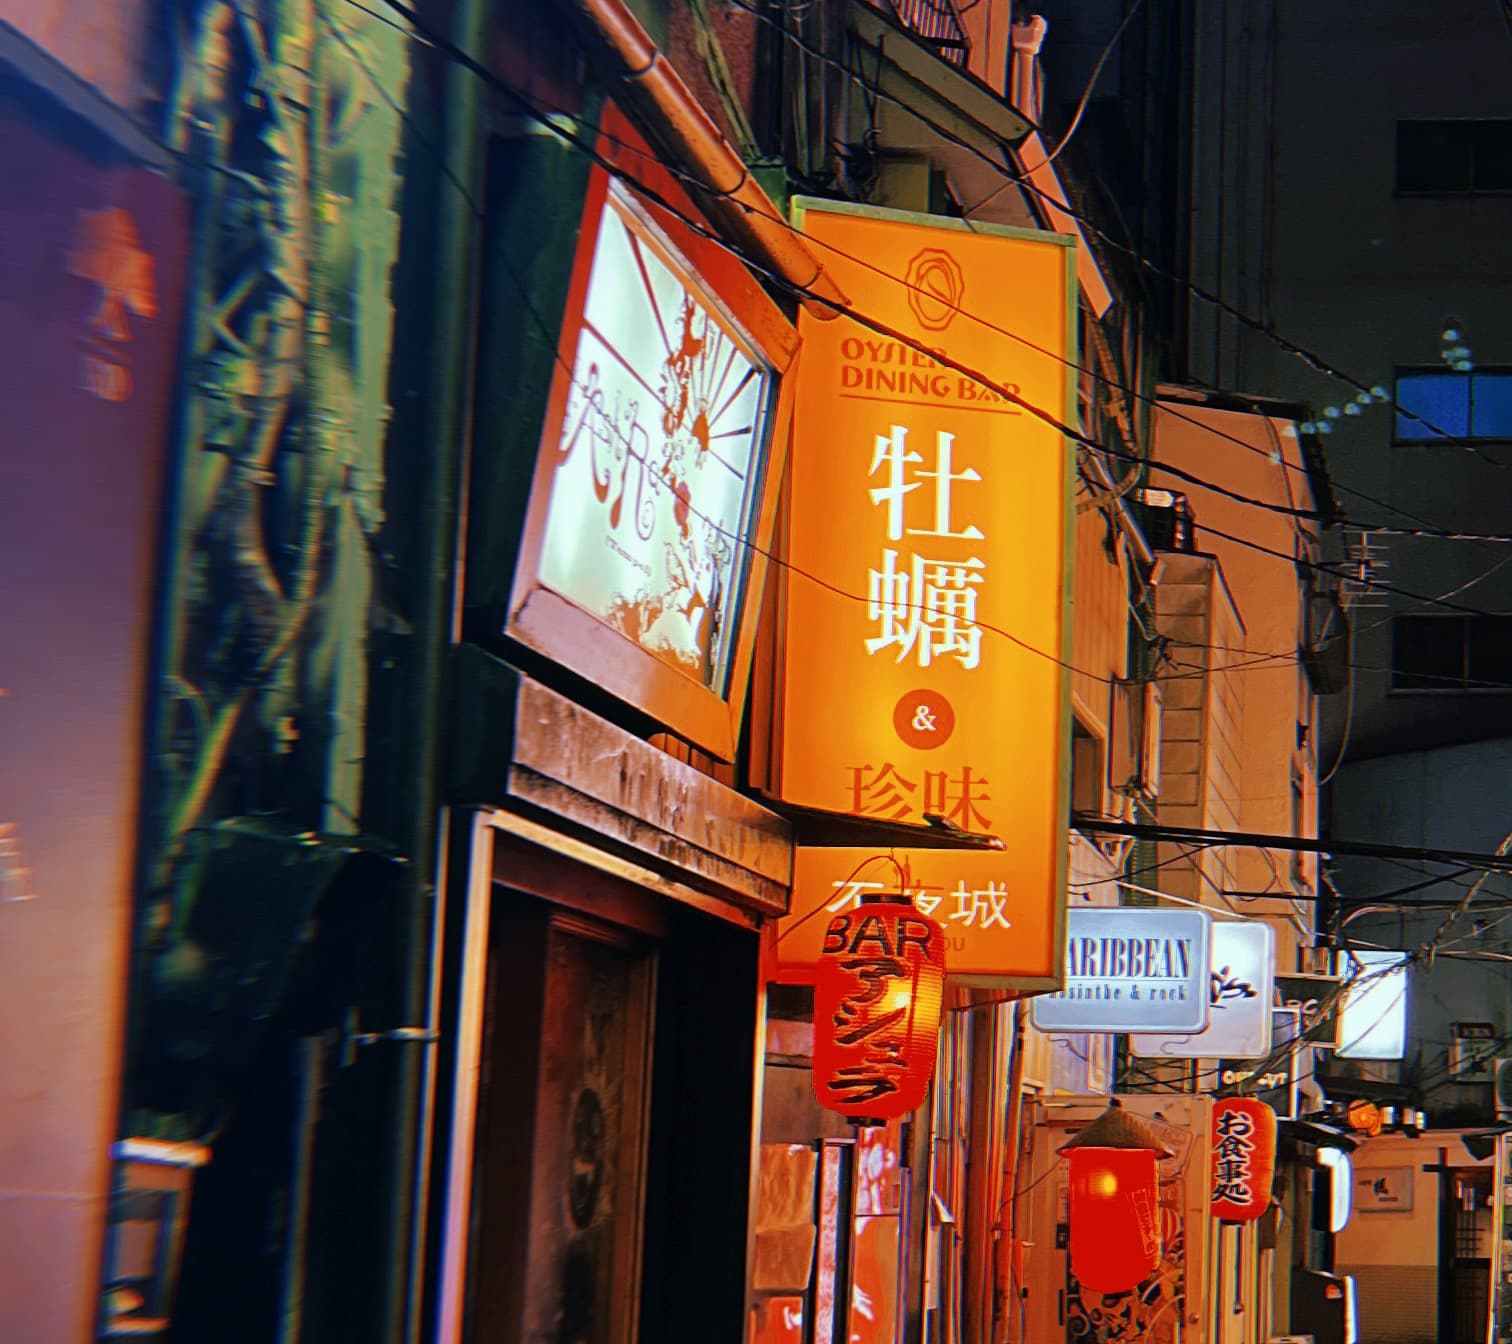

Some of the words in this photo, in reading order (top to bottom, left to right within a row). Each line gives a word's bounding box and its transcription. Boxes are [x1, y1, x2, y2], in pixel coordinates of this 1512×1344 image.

[840, 365, 950, 398] DINING
[866, 425, 986, 671] 牡蠣
[912, 704, 938, 732] &
[845, 762, 993, 831] 珍味
[822, 914, 933, 959] BAR
[1067, 937, 1193, 978] ARIBBEAN
[1209, 1110, 1256, 1206] お食事処
